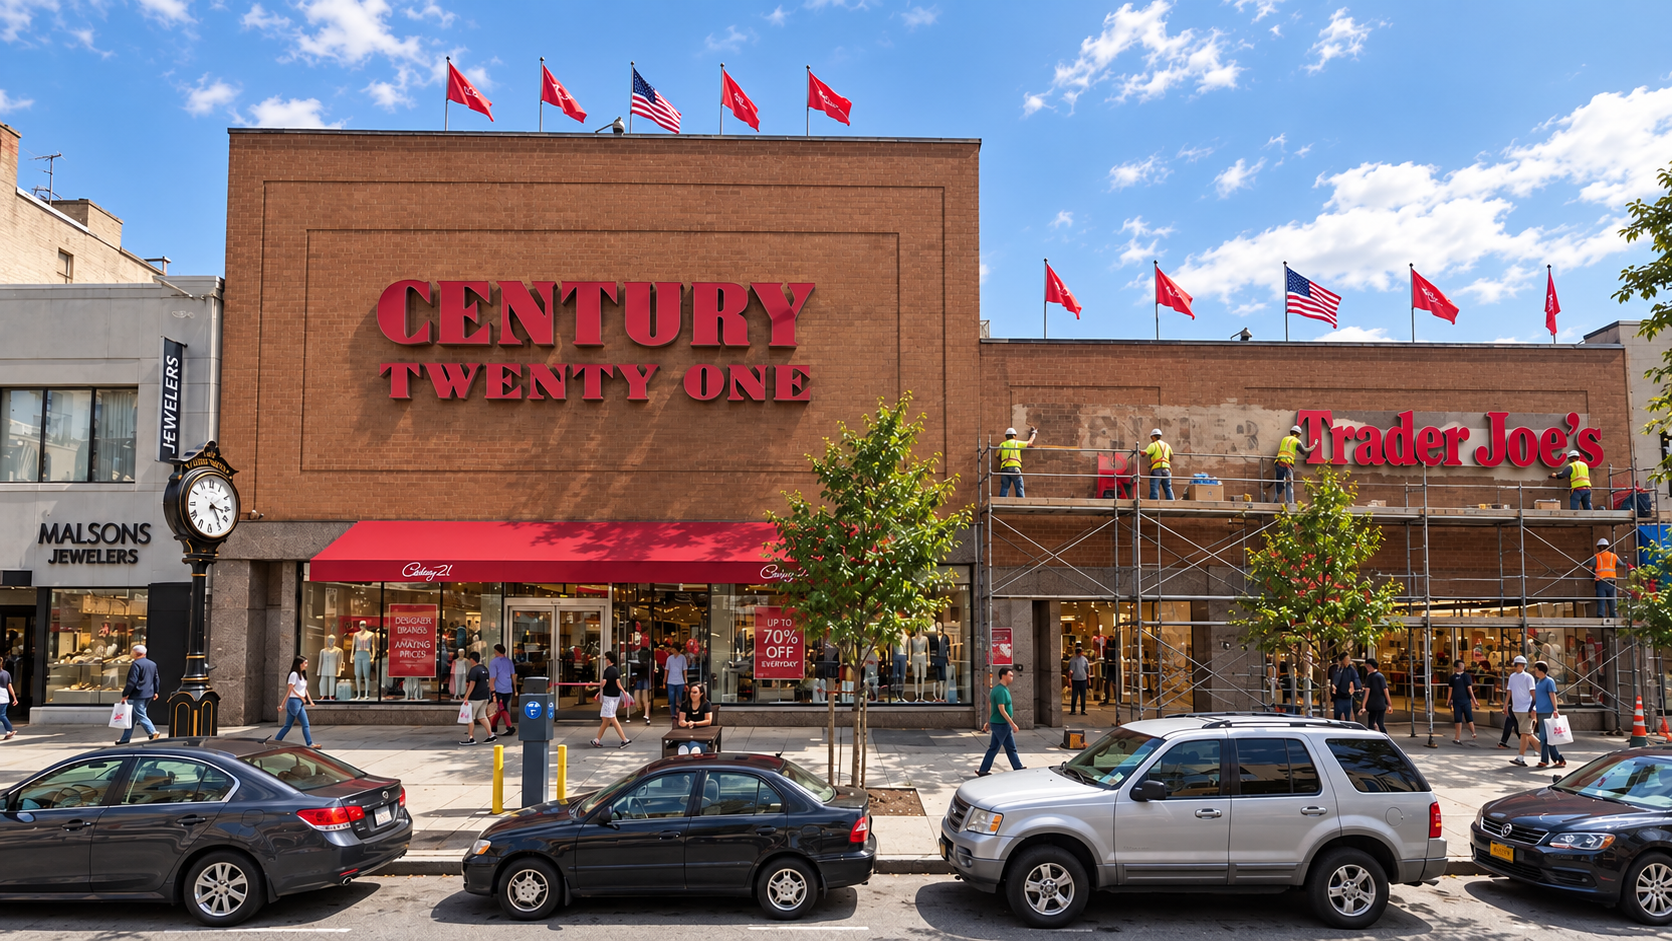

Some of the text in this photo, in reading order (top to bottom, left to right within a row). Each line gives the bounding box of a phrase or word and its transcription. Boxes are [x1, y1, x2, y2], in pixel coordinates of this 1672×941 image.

[377, 279, 816, 347] CENTURY
[379, 363, 812, 402] TWENTY ONE
[163, 354, 179, 454] JEWELERS
[1297, 409, 1470, 466] Trader
[1475, 411, 1605, 468] Joe's
[38, 522, 152, 545] MALSONS
[47, 549, 139, 565] JEWELERS
[767, 618, 793, 627] UP TO
[763, 629, 799, 645] 70%
[766, 645, 794, 659] OFF
[761, 660, 799, 668] EVERYDAY
